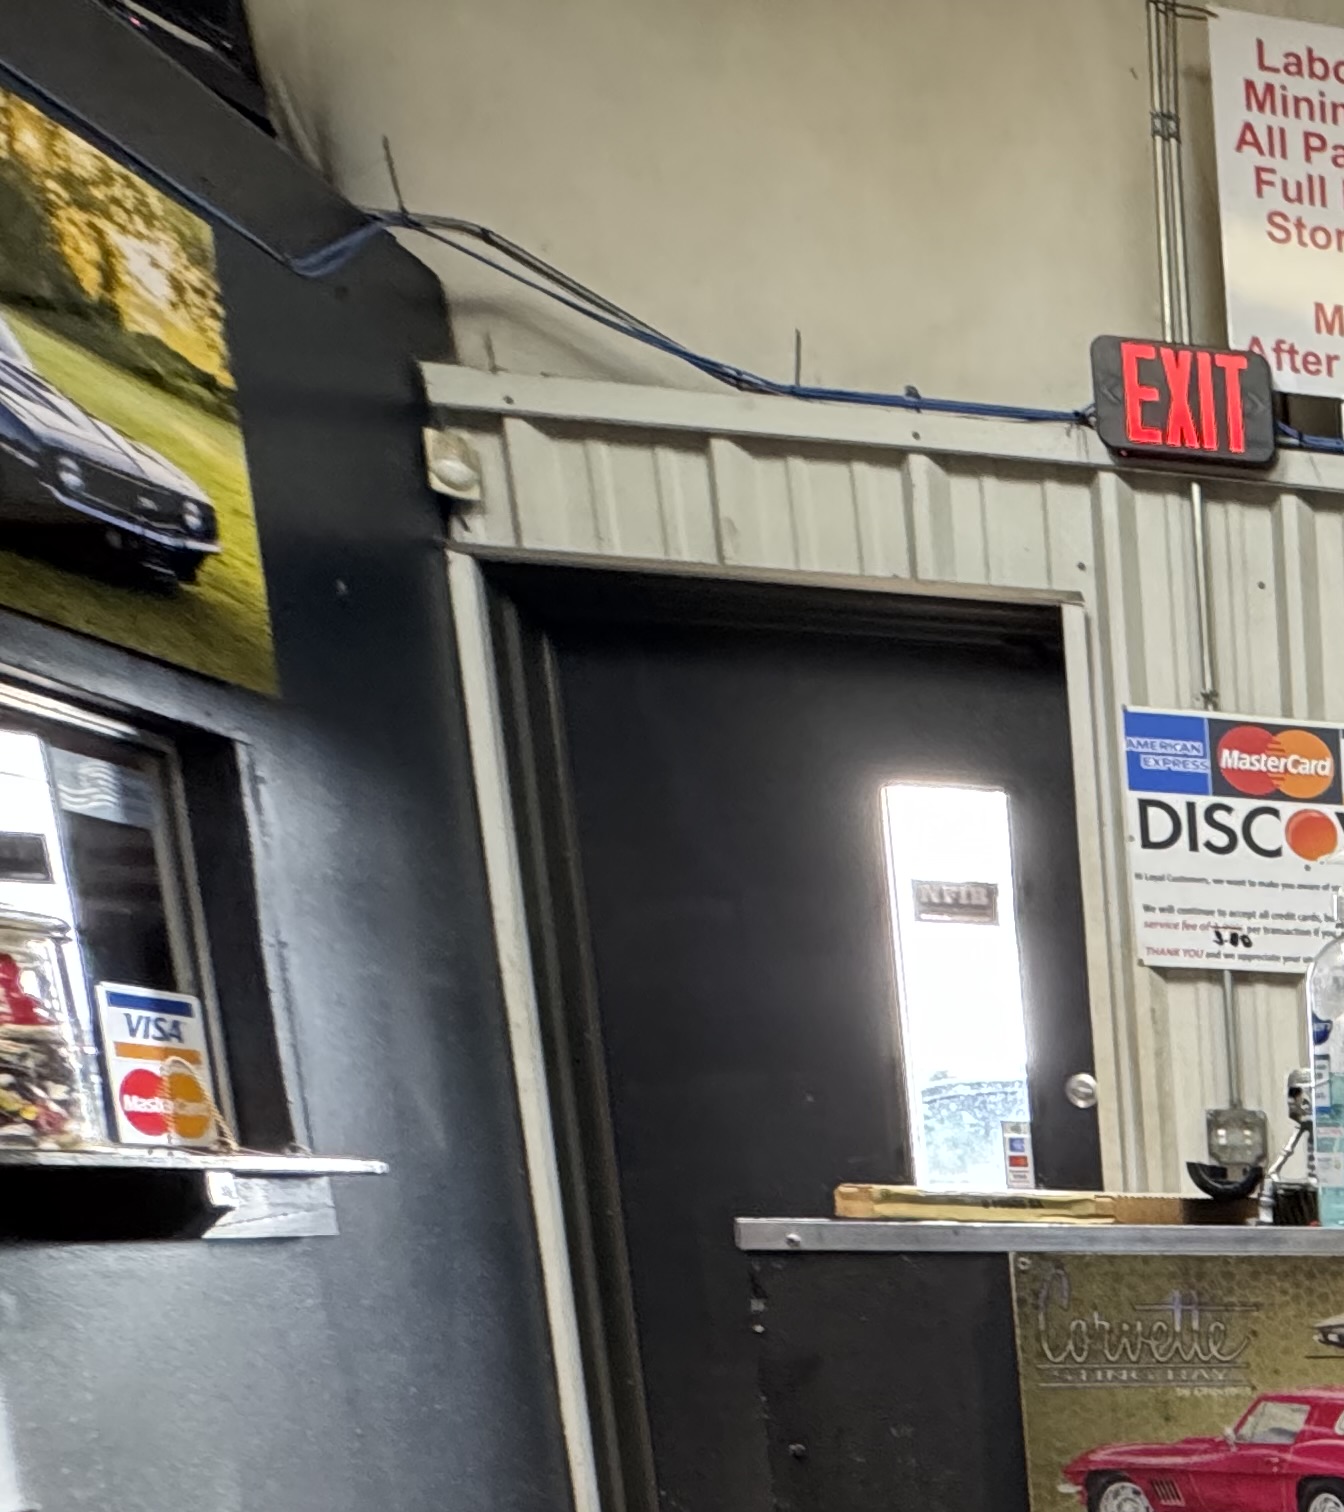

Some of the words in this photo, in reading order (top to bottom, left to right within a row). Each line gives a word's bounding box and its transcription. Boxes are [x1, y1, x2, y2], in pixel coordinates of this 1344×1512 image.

[1235, 122, 1287, 160] All
[1255, 169, 1327, 207] Full
[1120, 341, 1247, 452] EXIT
[1127, 738, 1202, 754] AMERICAN
[1142, 756, 1209, 771] EXPRESS
[1221, 750, 1331, 777] MasterCard
[1144, 920, 1179, 930] service
[1181, 920, 1197, 931] fee
[1146, 947, 1180, 957] THANK
[1183, 948, 1204, 958] YOU
[123, 1013, 185, 1043] VISA
